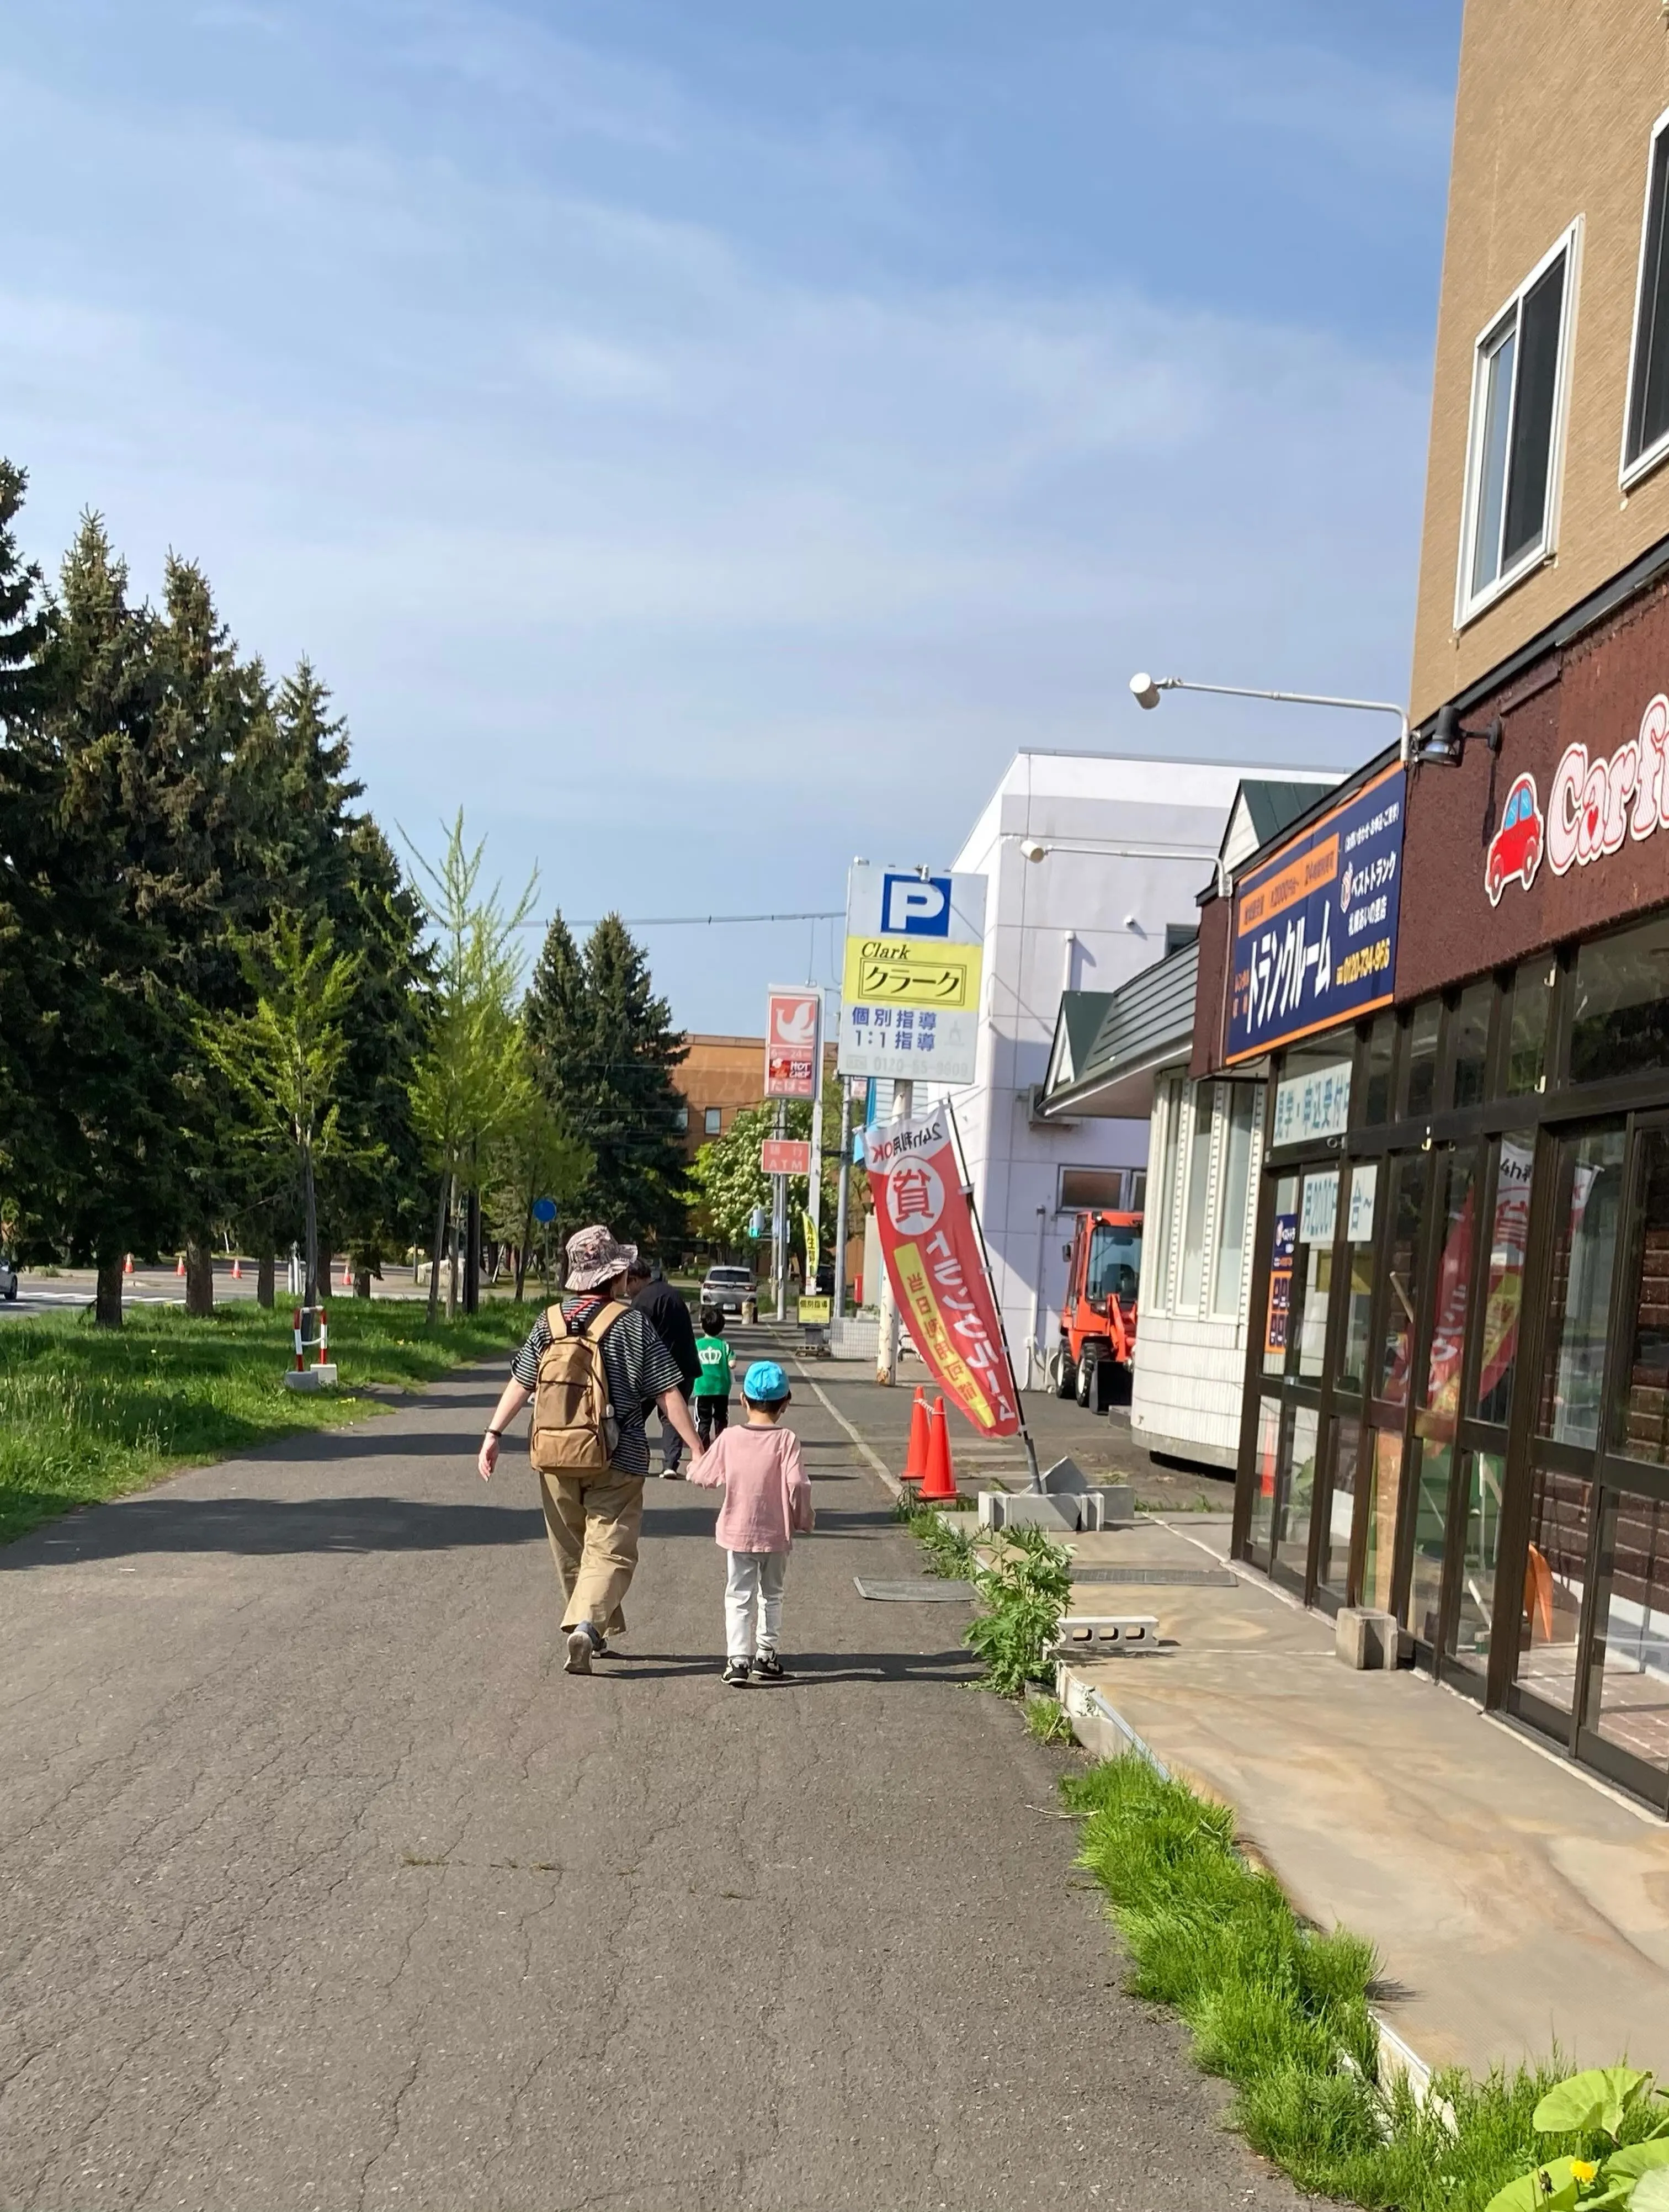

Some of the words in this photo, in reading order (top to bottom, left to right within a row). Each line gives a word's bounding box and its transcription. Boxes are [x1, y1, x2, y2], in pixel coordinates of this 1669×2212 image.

[1351, 849, 1397, 898] ベストトランク
[889, 881, 944, 930] P
[861, 942, 910, 959] Clark
[1246, 899, 1332, 1034] トランクルーム
[865, 966, 959, 998] クラーク
[852, 1006, 937, 1031] 個別指導
[790, 1061, 811, 1071] HOT
[769, 1159, 802, 1171] ATM
[800, 1299, 828, 1309] 個別指導
